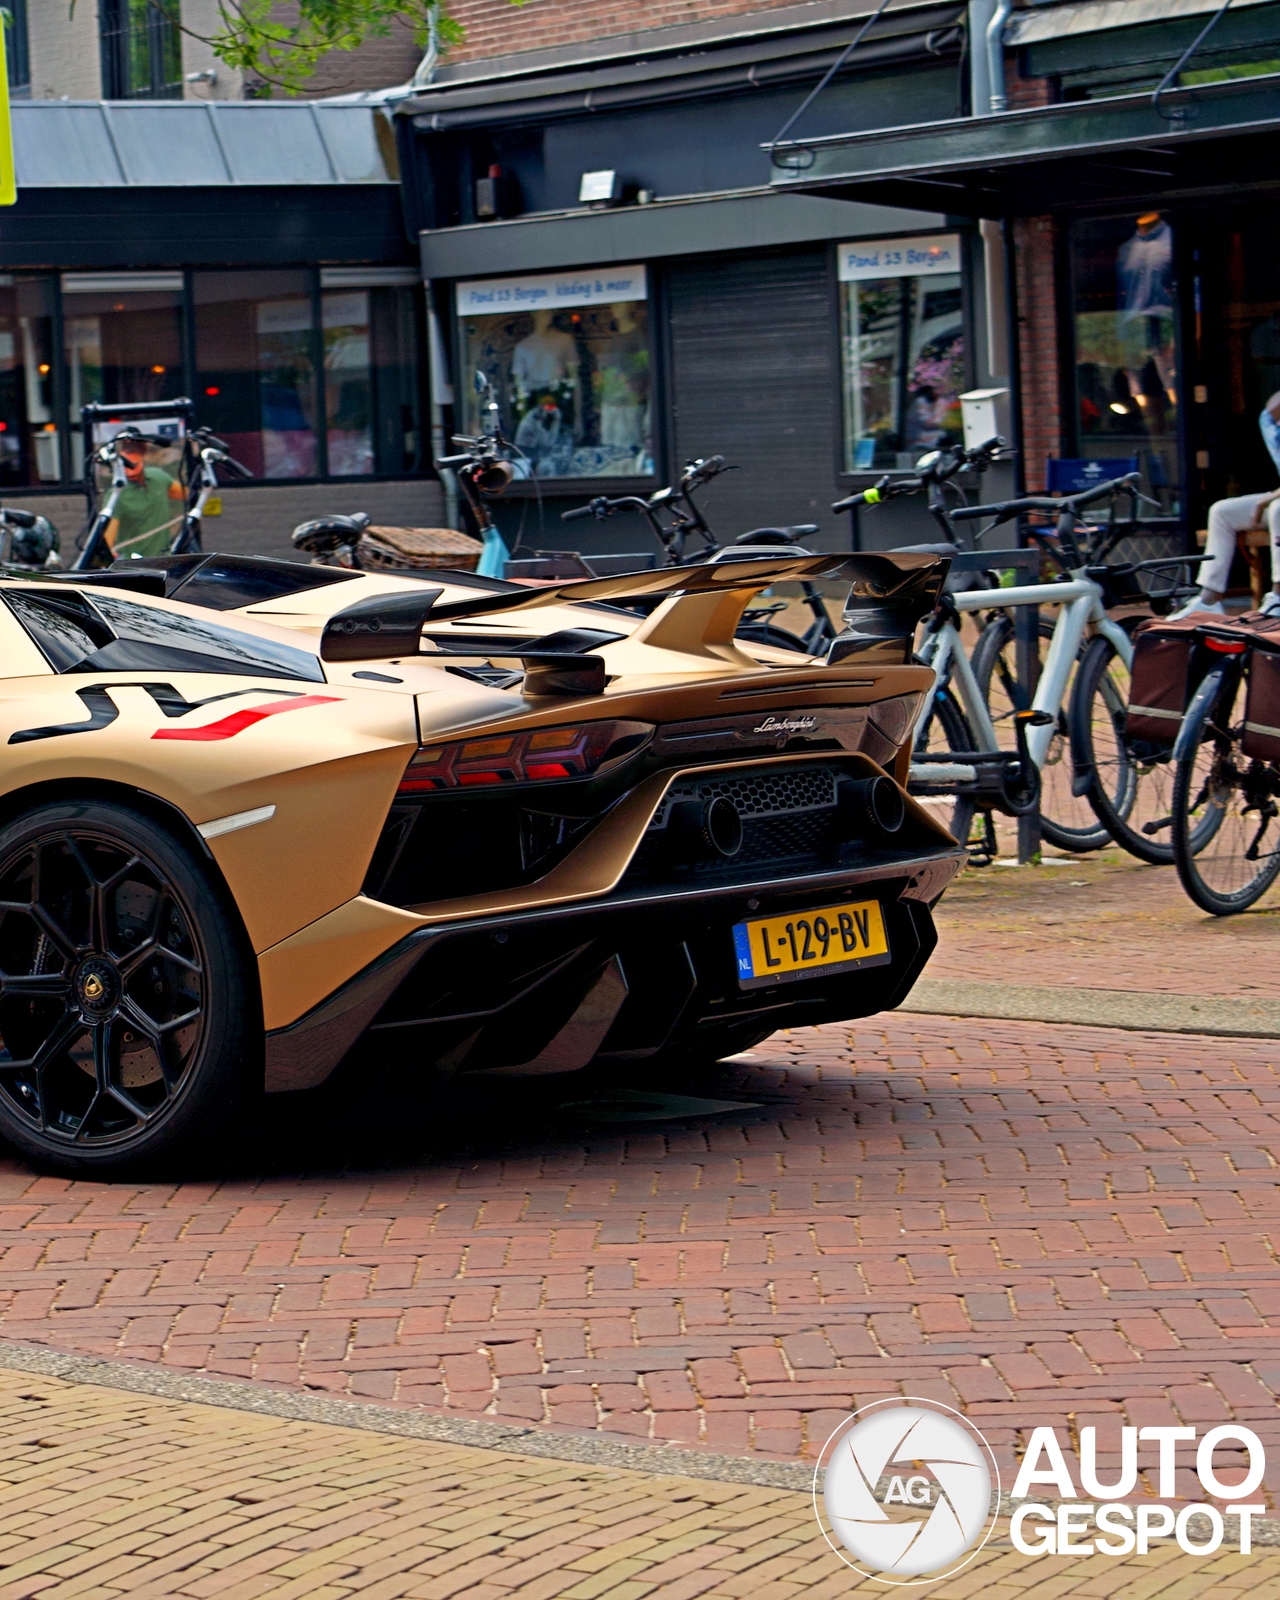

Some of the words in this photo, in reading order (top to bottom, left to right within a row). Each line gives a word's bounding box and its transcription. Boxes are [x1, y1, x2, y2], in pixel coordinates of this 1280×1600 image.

[847, 250, 879, 268] Pand
[753, 716, 817, 734] Lamborghini
[761, 908, 869, 967] L-129-BV
[738, 957, 751, 971] NL
